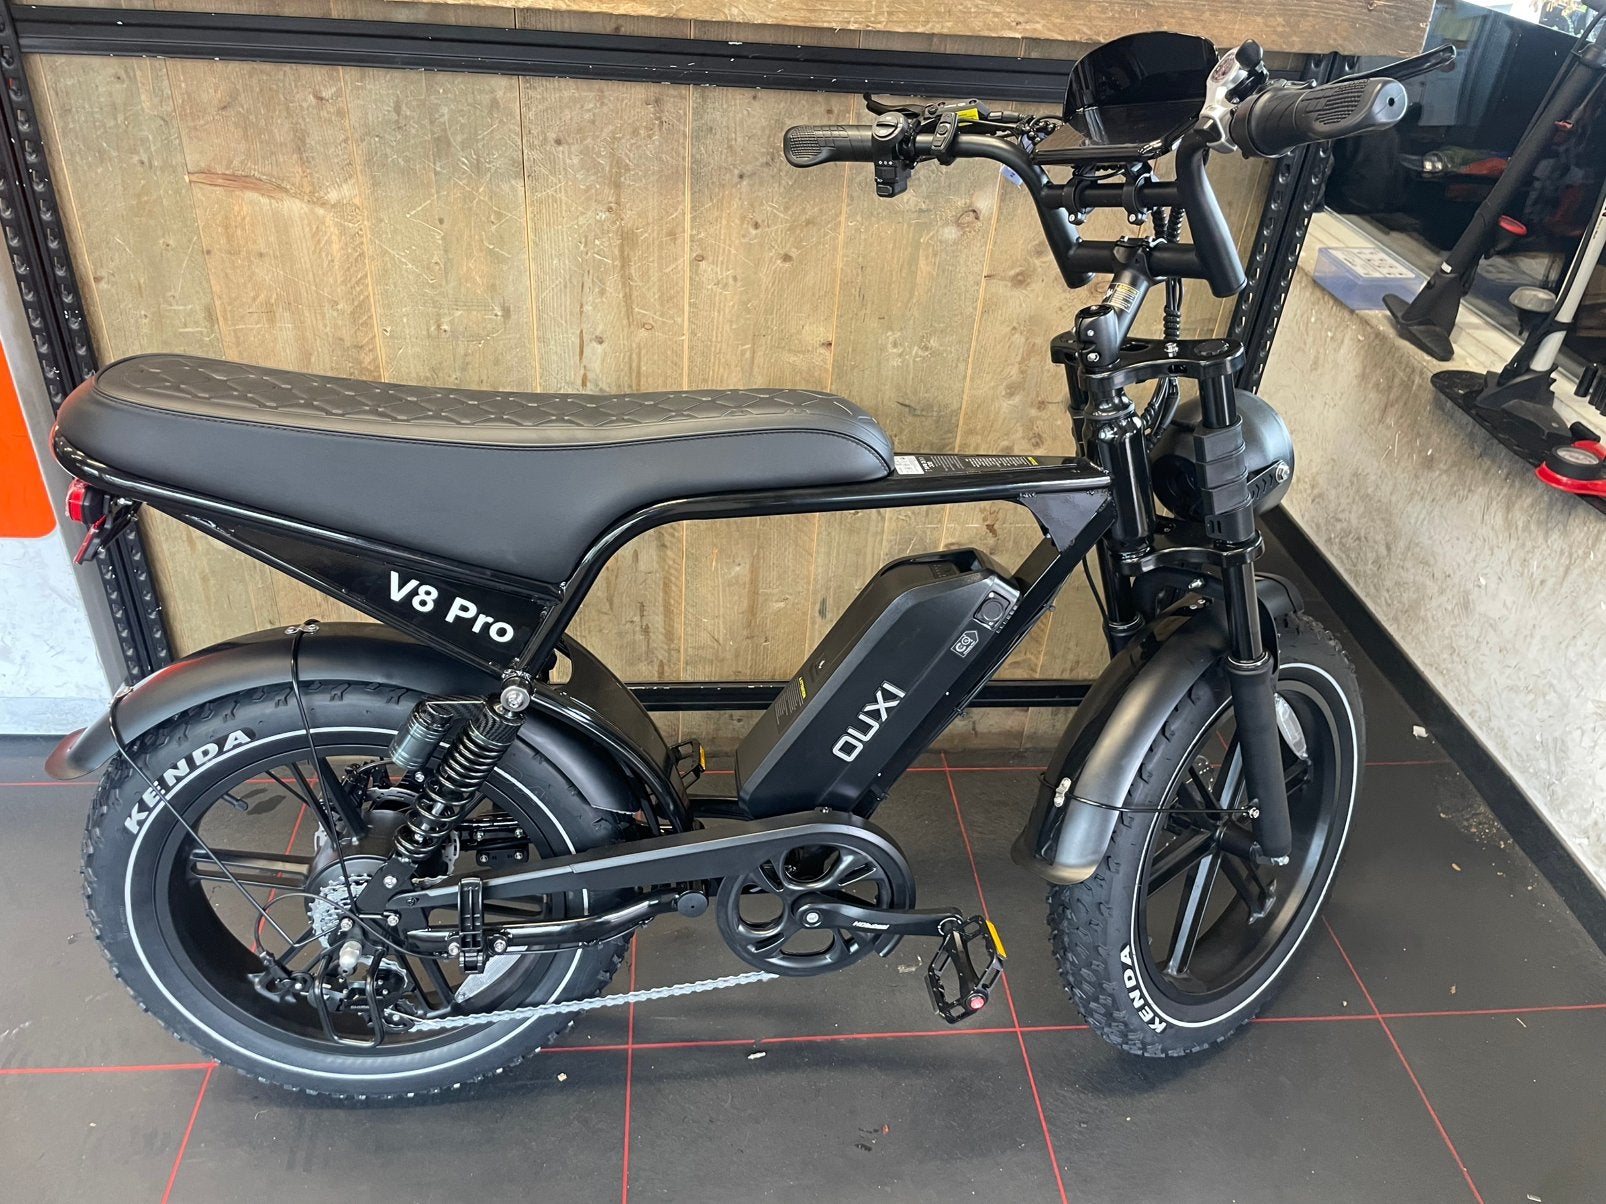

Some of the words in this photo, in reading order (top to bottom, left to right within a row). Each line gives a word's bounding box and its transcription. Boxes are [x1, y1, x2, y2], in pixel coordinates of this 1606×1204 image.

[390, 570, 438, 613] V8
[445, 596, 514, 643] Pro
[832, 681, 906, 762] OUXI
[124, 729, 251, 835] KENDA
[1120, 944, 1167, 1033] KENDA
